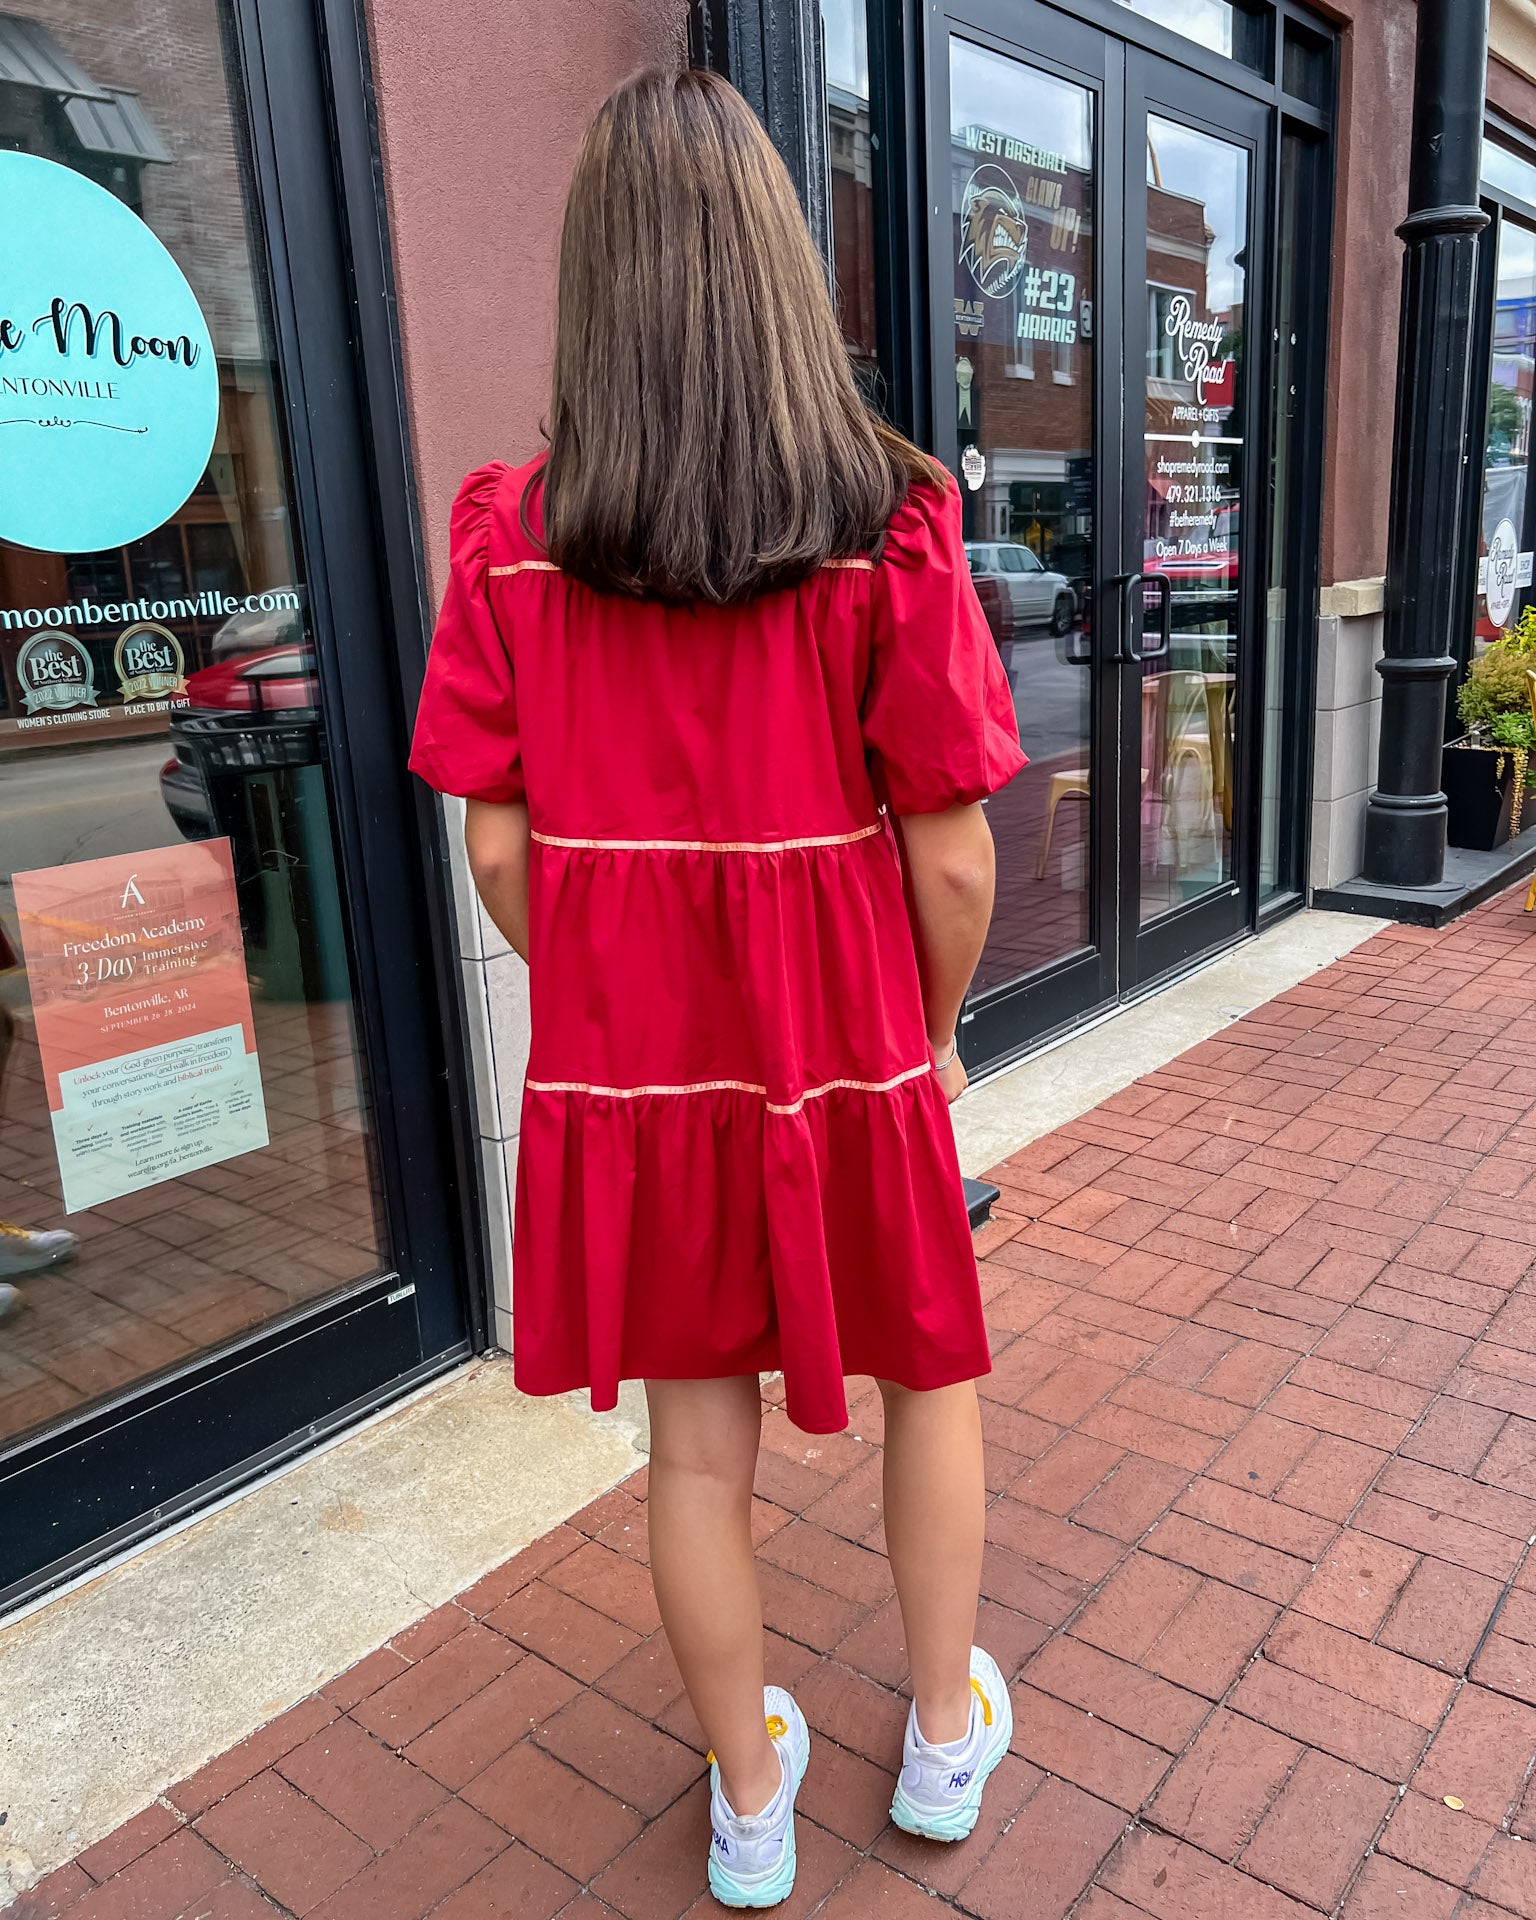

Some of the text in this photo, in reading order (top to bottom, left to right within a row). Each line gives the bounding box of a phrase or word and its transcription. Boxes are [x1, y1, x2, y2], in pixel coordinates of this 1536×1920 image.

[965, 126, 1067, 175] WEST BASEBALL
[1026, 176, 1063, 209] CLAWS
[1050, 206, 1081, 253] UP!
[1024, 267, 1075, 312] #23
[0, 297, 199, 369] e Moon
[1017, 312, 1077, 344] HARRIS
[1165, 295, 1223, 361] Remedy
[1184, 341, 1227, 405] Road
[0, 376, 120, 400] NTONVILLE
[1157, 455, 1230, 478] shopremedyroad.com
[1165, 485, 1222, 503] 479.321.1316
[1169, 510, 1217, 530] #betheremedy
[1156, 541, 1177, 561] Open
[1178, 540, 1184, 555] 7
[1185, 540, 1202, 558] Days
[1208, 536, 1228, 552] Week
[0, 590, 300, 630] moonbentonville.com
[45, 649, 63, 662] the
[125, 646, 174, 671] Best
[140, 640, 157, 652] the
[28, 655, 82, 681] Best
[54, 687, 87, 700] WINNER
[148, 676, 178, 689] WINNER
[17, 708, 111, 729] WOMEN'S CLOTHING STORE
[124, 698, 190, 715] PLACE TO BUY A GIFT
[63, 917, 208, 957] Freedom Academy
[142, 940, 208, 961] Immersive
[77, 956, 137, 985] 3-Day
[144, 955, 197, 975] Training
[104, 988, 189, 1018] Bentonville, AR
[100, 1016, 150, 1034] SEPTEMBER
[177, 1003, 196, 1014] 2024
[73, 1071, 101, 1085] Unlock
[101, 1066, 120, 1078] your
[197, 1035, 233, 1050] transform
[82, 1087, 101, 1099] your
[158, 1065, 173, 1075] and
[173, 1061, 189, 1071] walk
[190, 1059, 198, 1067] in
[198, 1049, 228, 1063] freedom
[91, 1094, 123, 1109] through
[123, 1088, 144, 1101] story
[143, 1082, 162, 1092] work
[163, 1077, 178, 1087] and
[177, 1070, 203, 1083] biblical
[135, 1155, 155, 1167] Learn
[155, 1149, 173, 1160] more
[180, 1142, 194, 1152] sign
